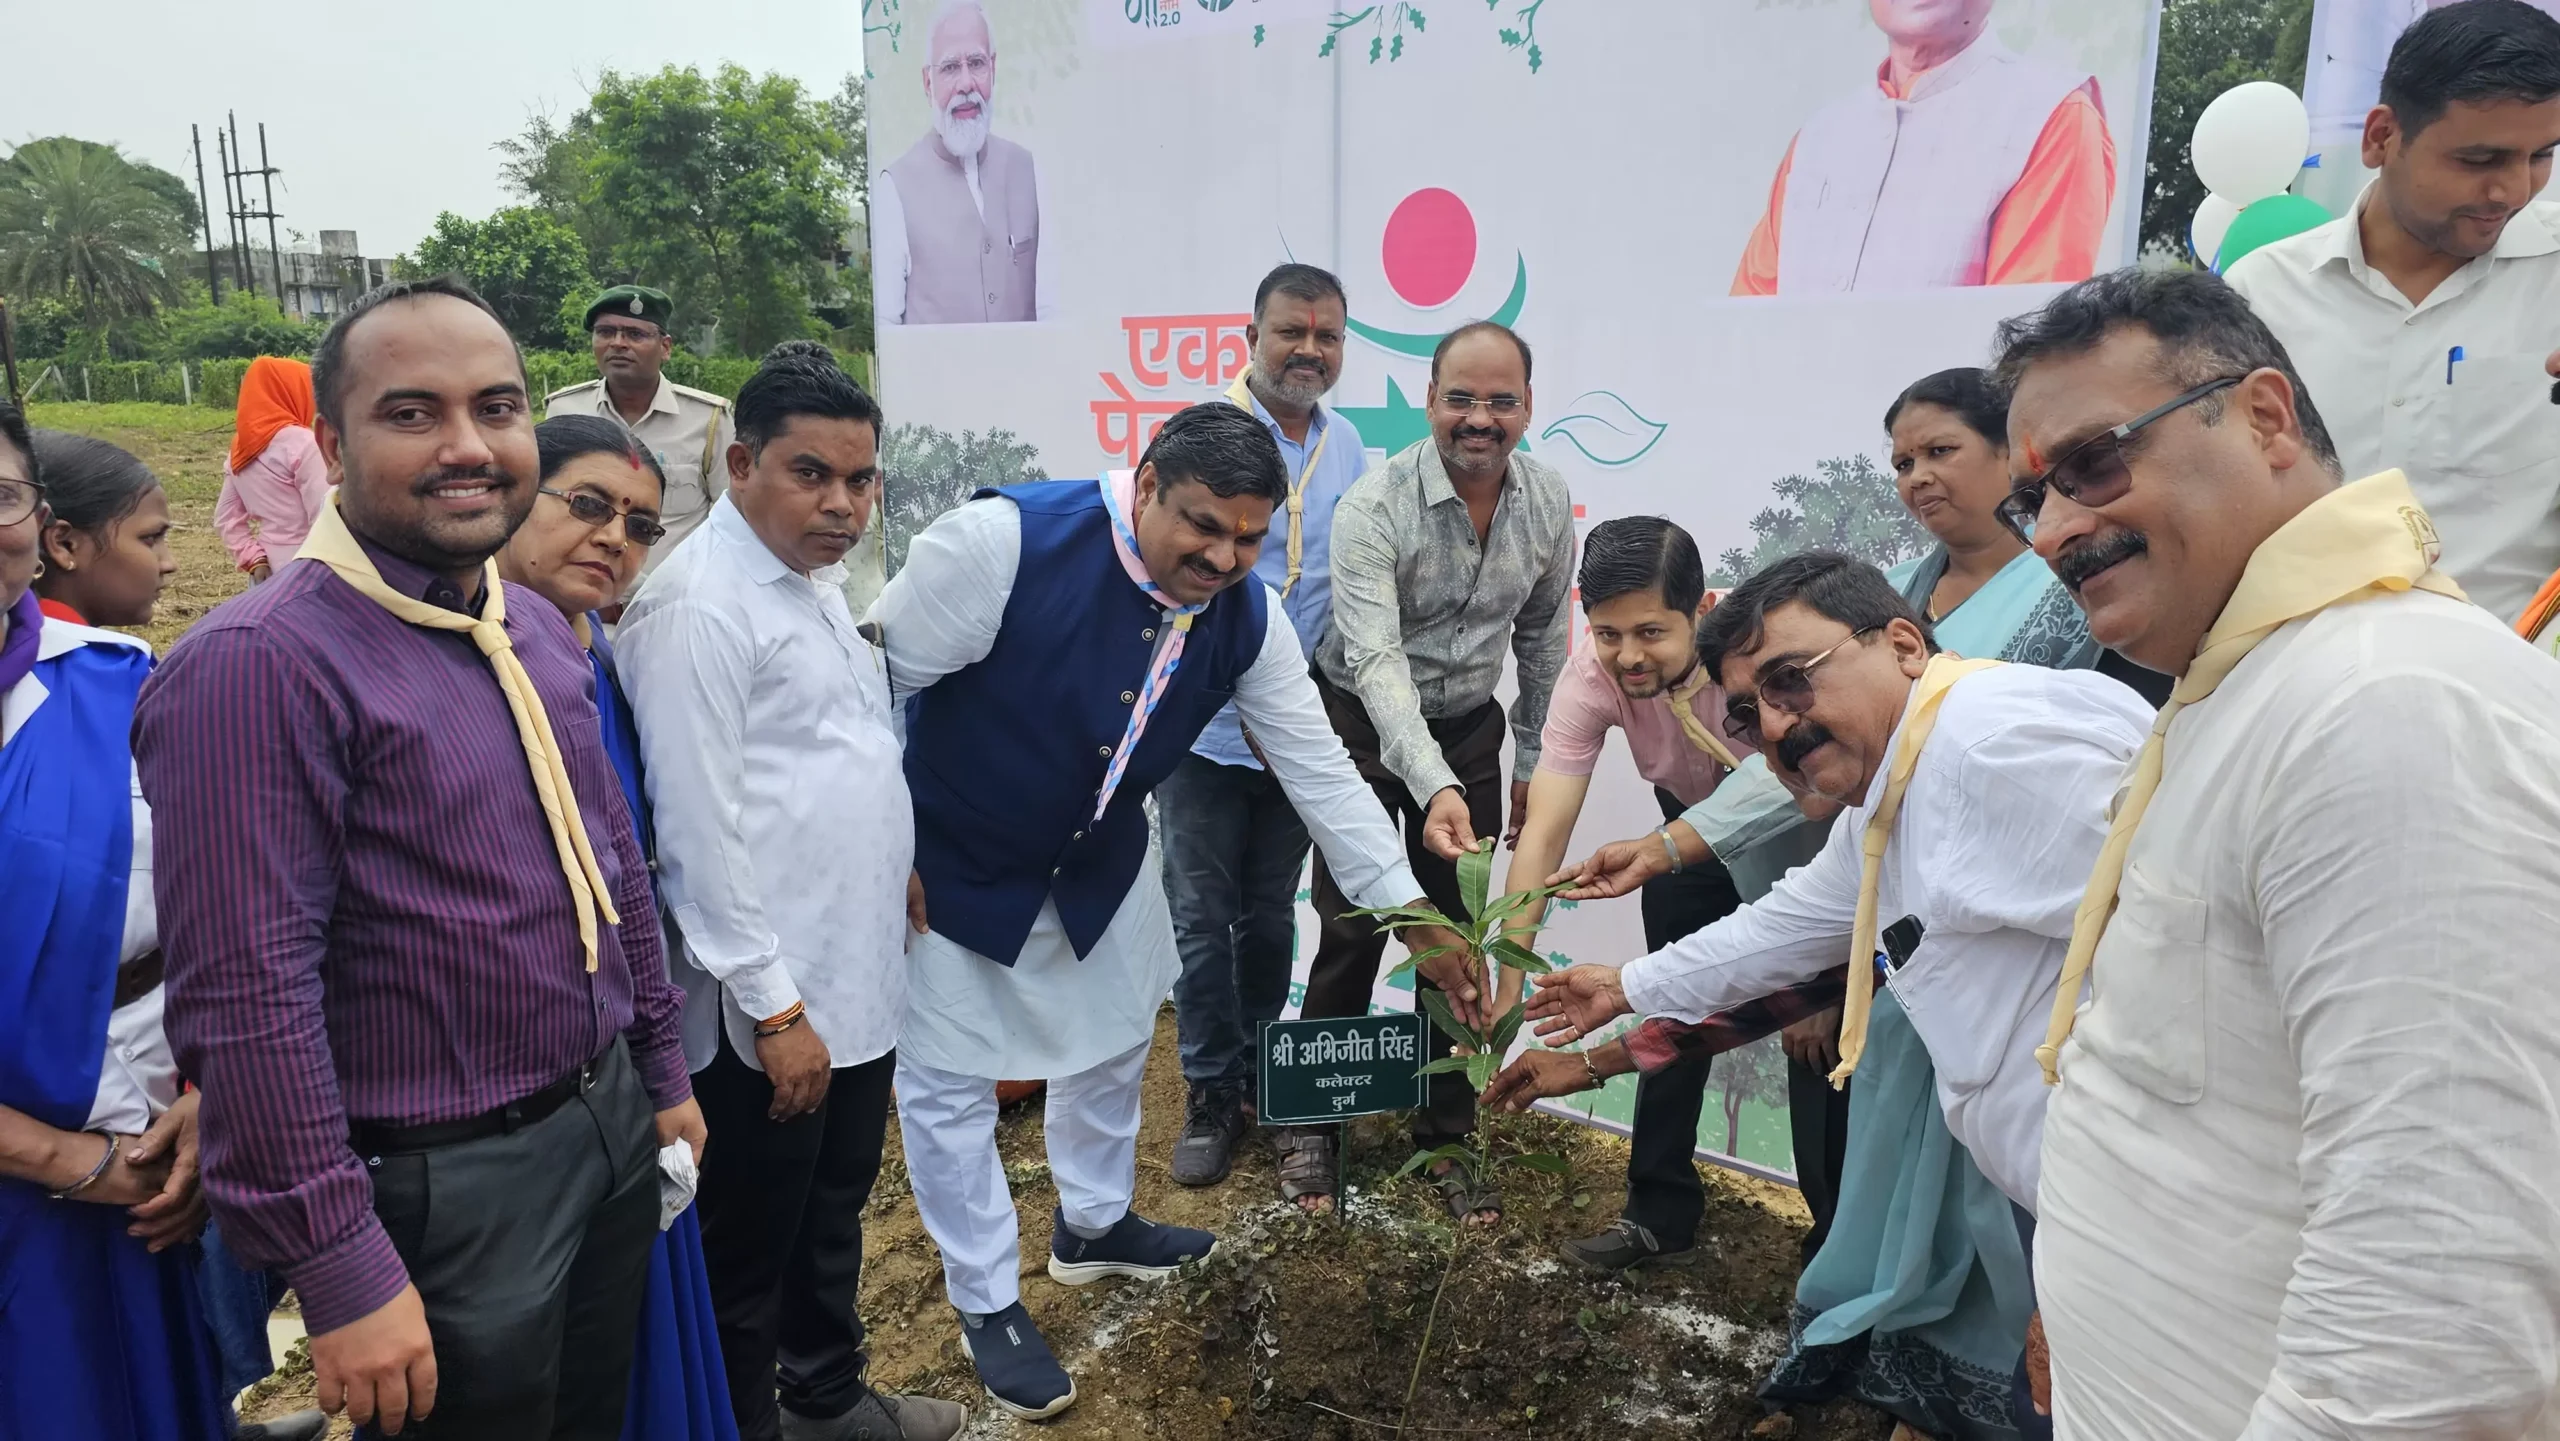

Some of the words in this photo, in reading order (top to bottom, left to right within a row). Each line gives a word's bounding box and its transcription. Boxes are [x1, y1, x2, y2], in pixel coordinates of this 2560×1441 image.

[1160, 11, 1181, 27] 2.0
[1121, 313, 1252, 387] एक
[1089, 372, 1196, 468] पे
[1272, 1032, 1295, 1067] श्री
[1299, 1028, 1375, 1065] अभिजीत
[1378, 1025, 1415, 1061] सिंह
[1315, 1072, 1373, 1089] कलेक्टर
[1332, 1091, 1357, 1112] दुर्ग
